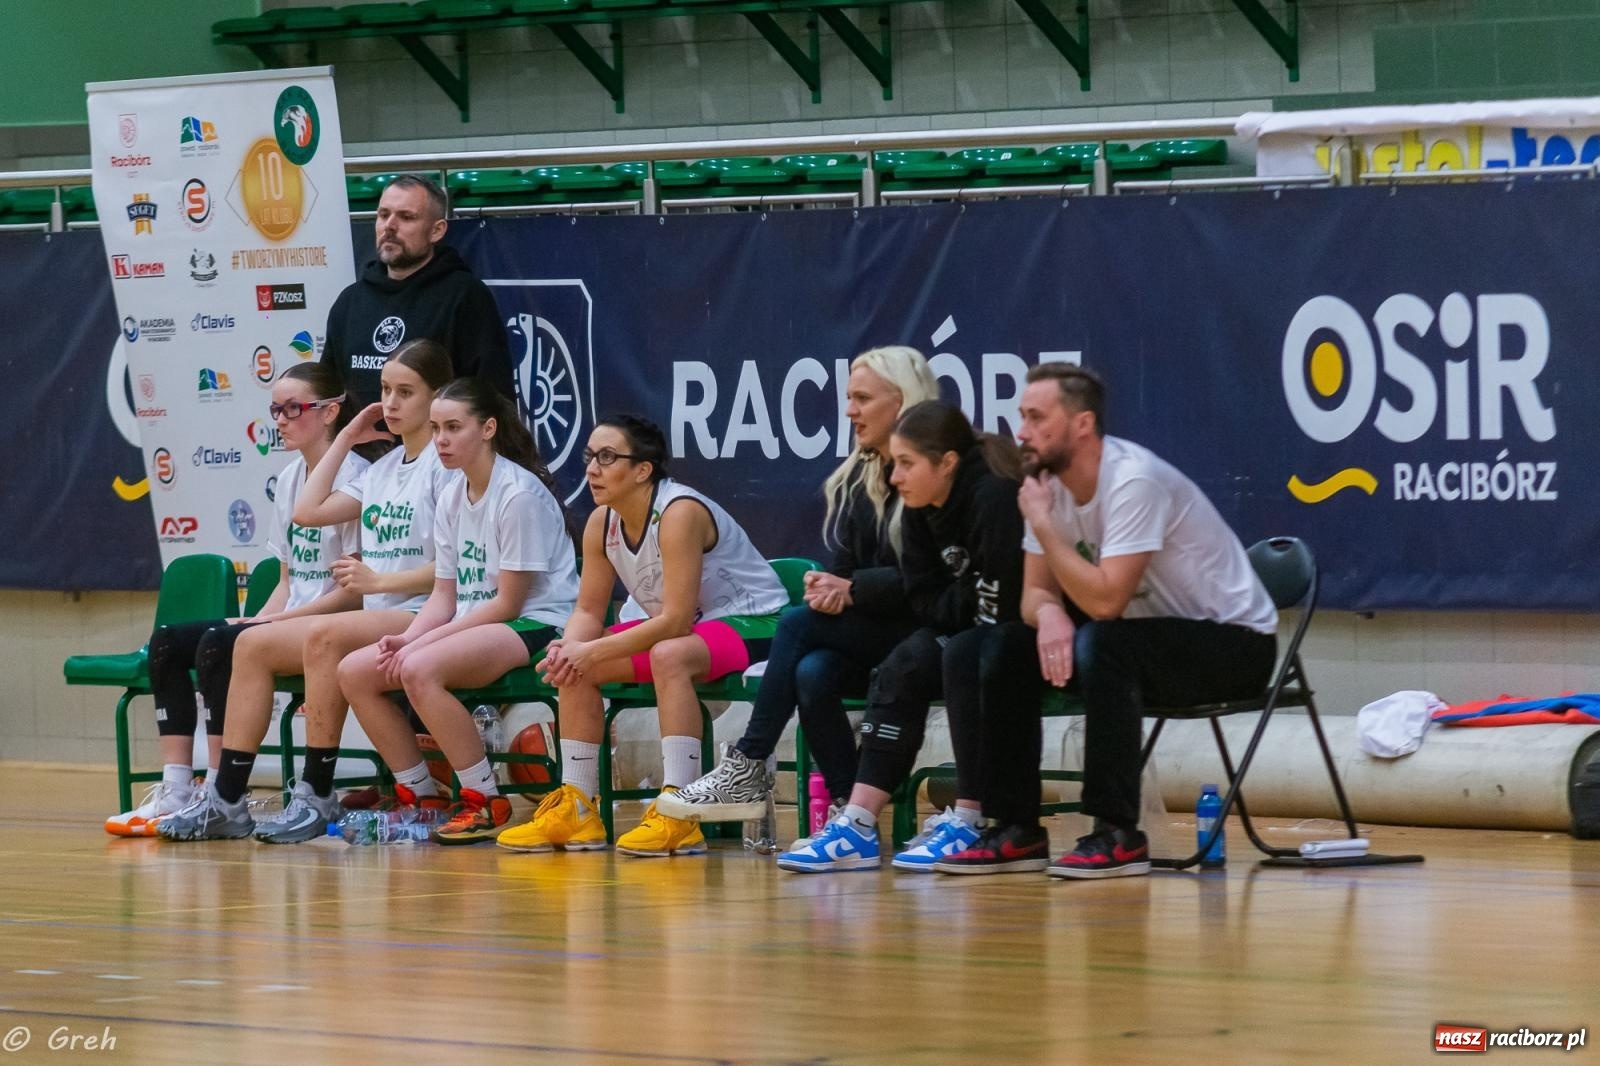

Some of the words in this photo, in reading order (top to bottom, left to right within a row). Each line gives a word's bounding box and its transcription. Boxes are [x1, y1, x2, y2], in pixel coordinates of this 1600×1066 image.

[257, 151, 285, 201] 10
[140, 318, 175, 329] AKADEMIA
[201, 314, 235, 329] Clavis
[204, 448, 241, 464] Clavis
[1393, 447, 1558, 502] RACIBÓRZ
